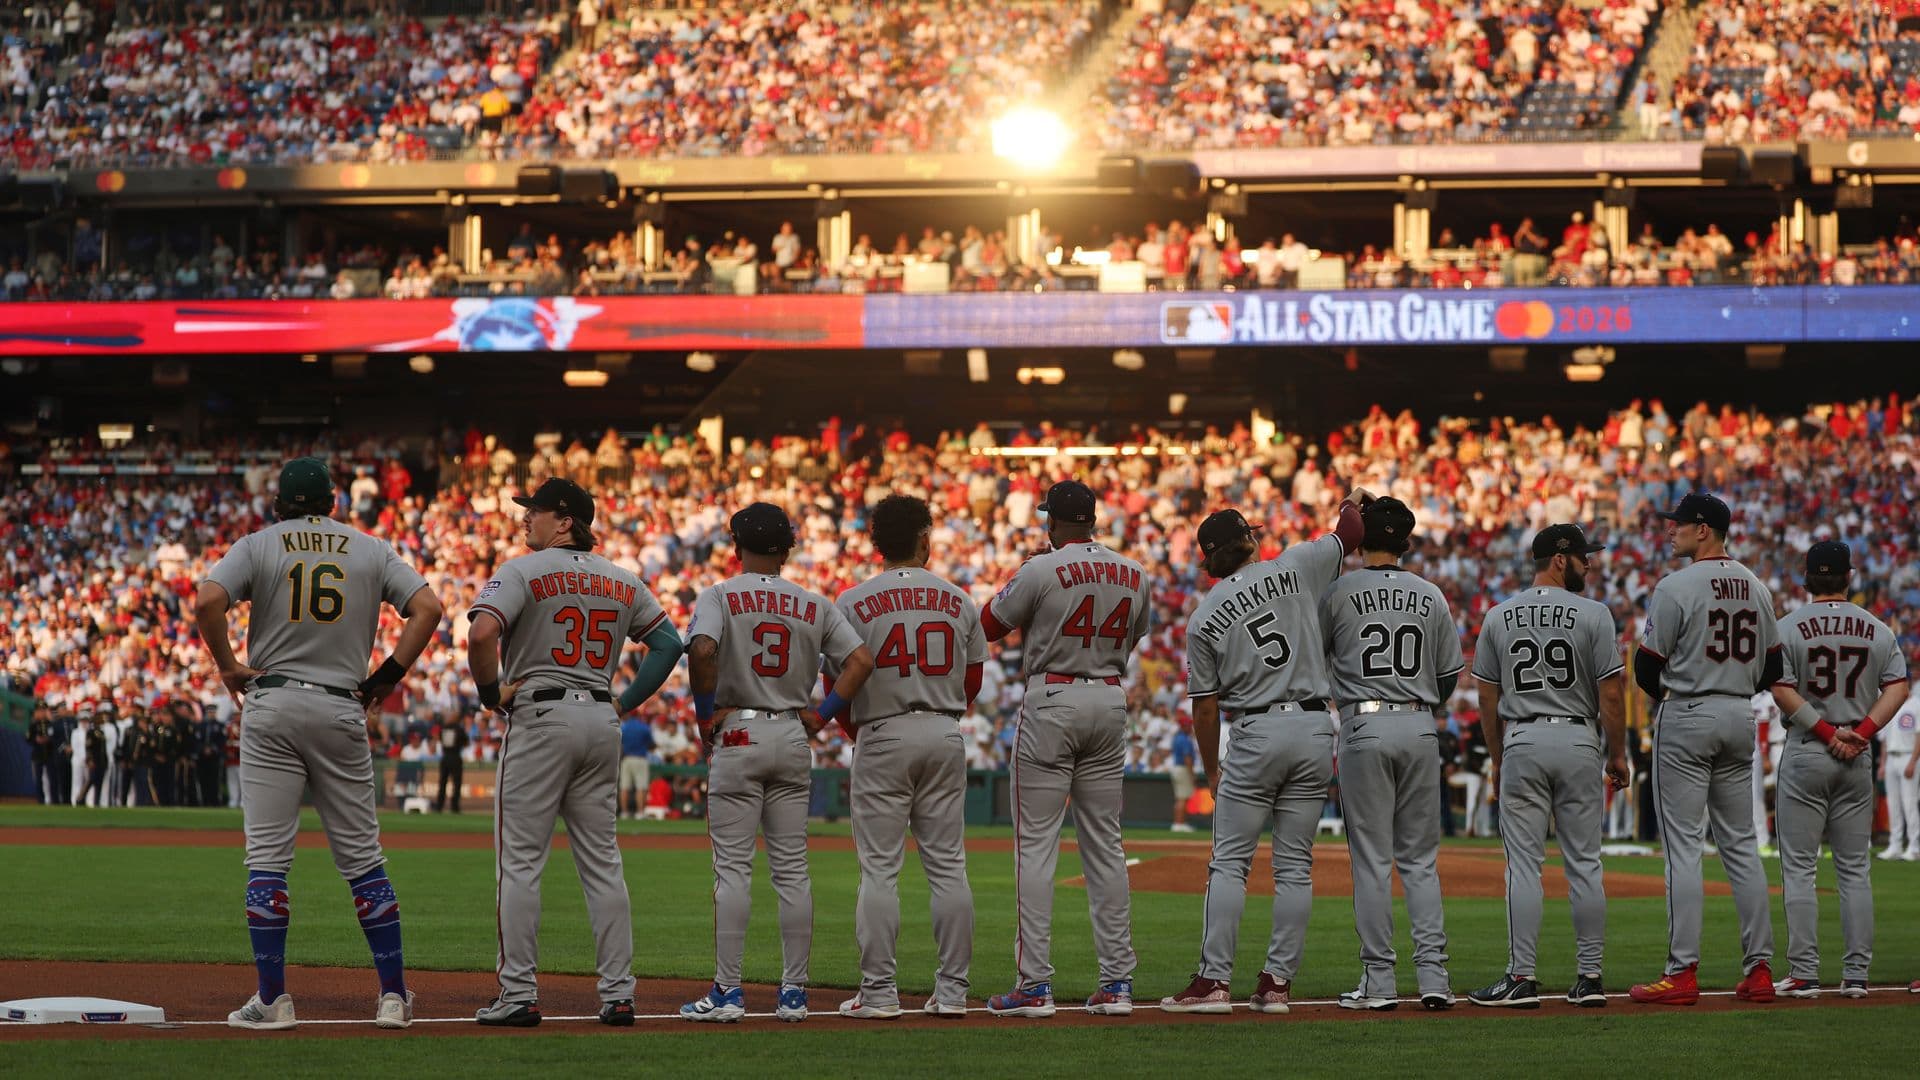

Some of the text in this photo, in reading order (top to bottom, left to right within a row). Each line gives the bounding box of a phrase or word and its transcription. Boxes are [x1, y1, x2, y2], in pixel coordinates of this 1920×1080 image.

[1399, 293, 1496, 342] GAME
[1559, 305, 1633, 333] 2026
[282, 531, 350, 554] KURTZ
[287, 560, 345, 624] 16
[529, 571, 637, 609] RUTSCHMAN
[1055, 561, 1141, 593] CHAPMAN
[1349, 588, 1433, 618] VARGAS
[1710, 578, 1750, 601] SMITH
[726, 590, 817, 625] RAFAELA
[853, 587, 962, 624] CONTRERAS
[1061, 594, 1133, 650] 44
[1199, 570, 1300, 643] MURAKAMI
[1503, 605, 1578, 632] PETERS
[1797, 615, 1875, 642] BAZZANA
[551, 606, 619, 669] 35
[751, 621, 791, 678] 3
[875, 620, 955, 678] 40
[1245, 609, 1292, 670] 5
[1359, 621, 1425, 680] 20
[1705, 607, 1758, 665] 36
[1509, 637, 1578, 694] 29
[1807, 644, 1870, 700] 37
